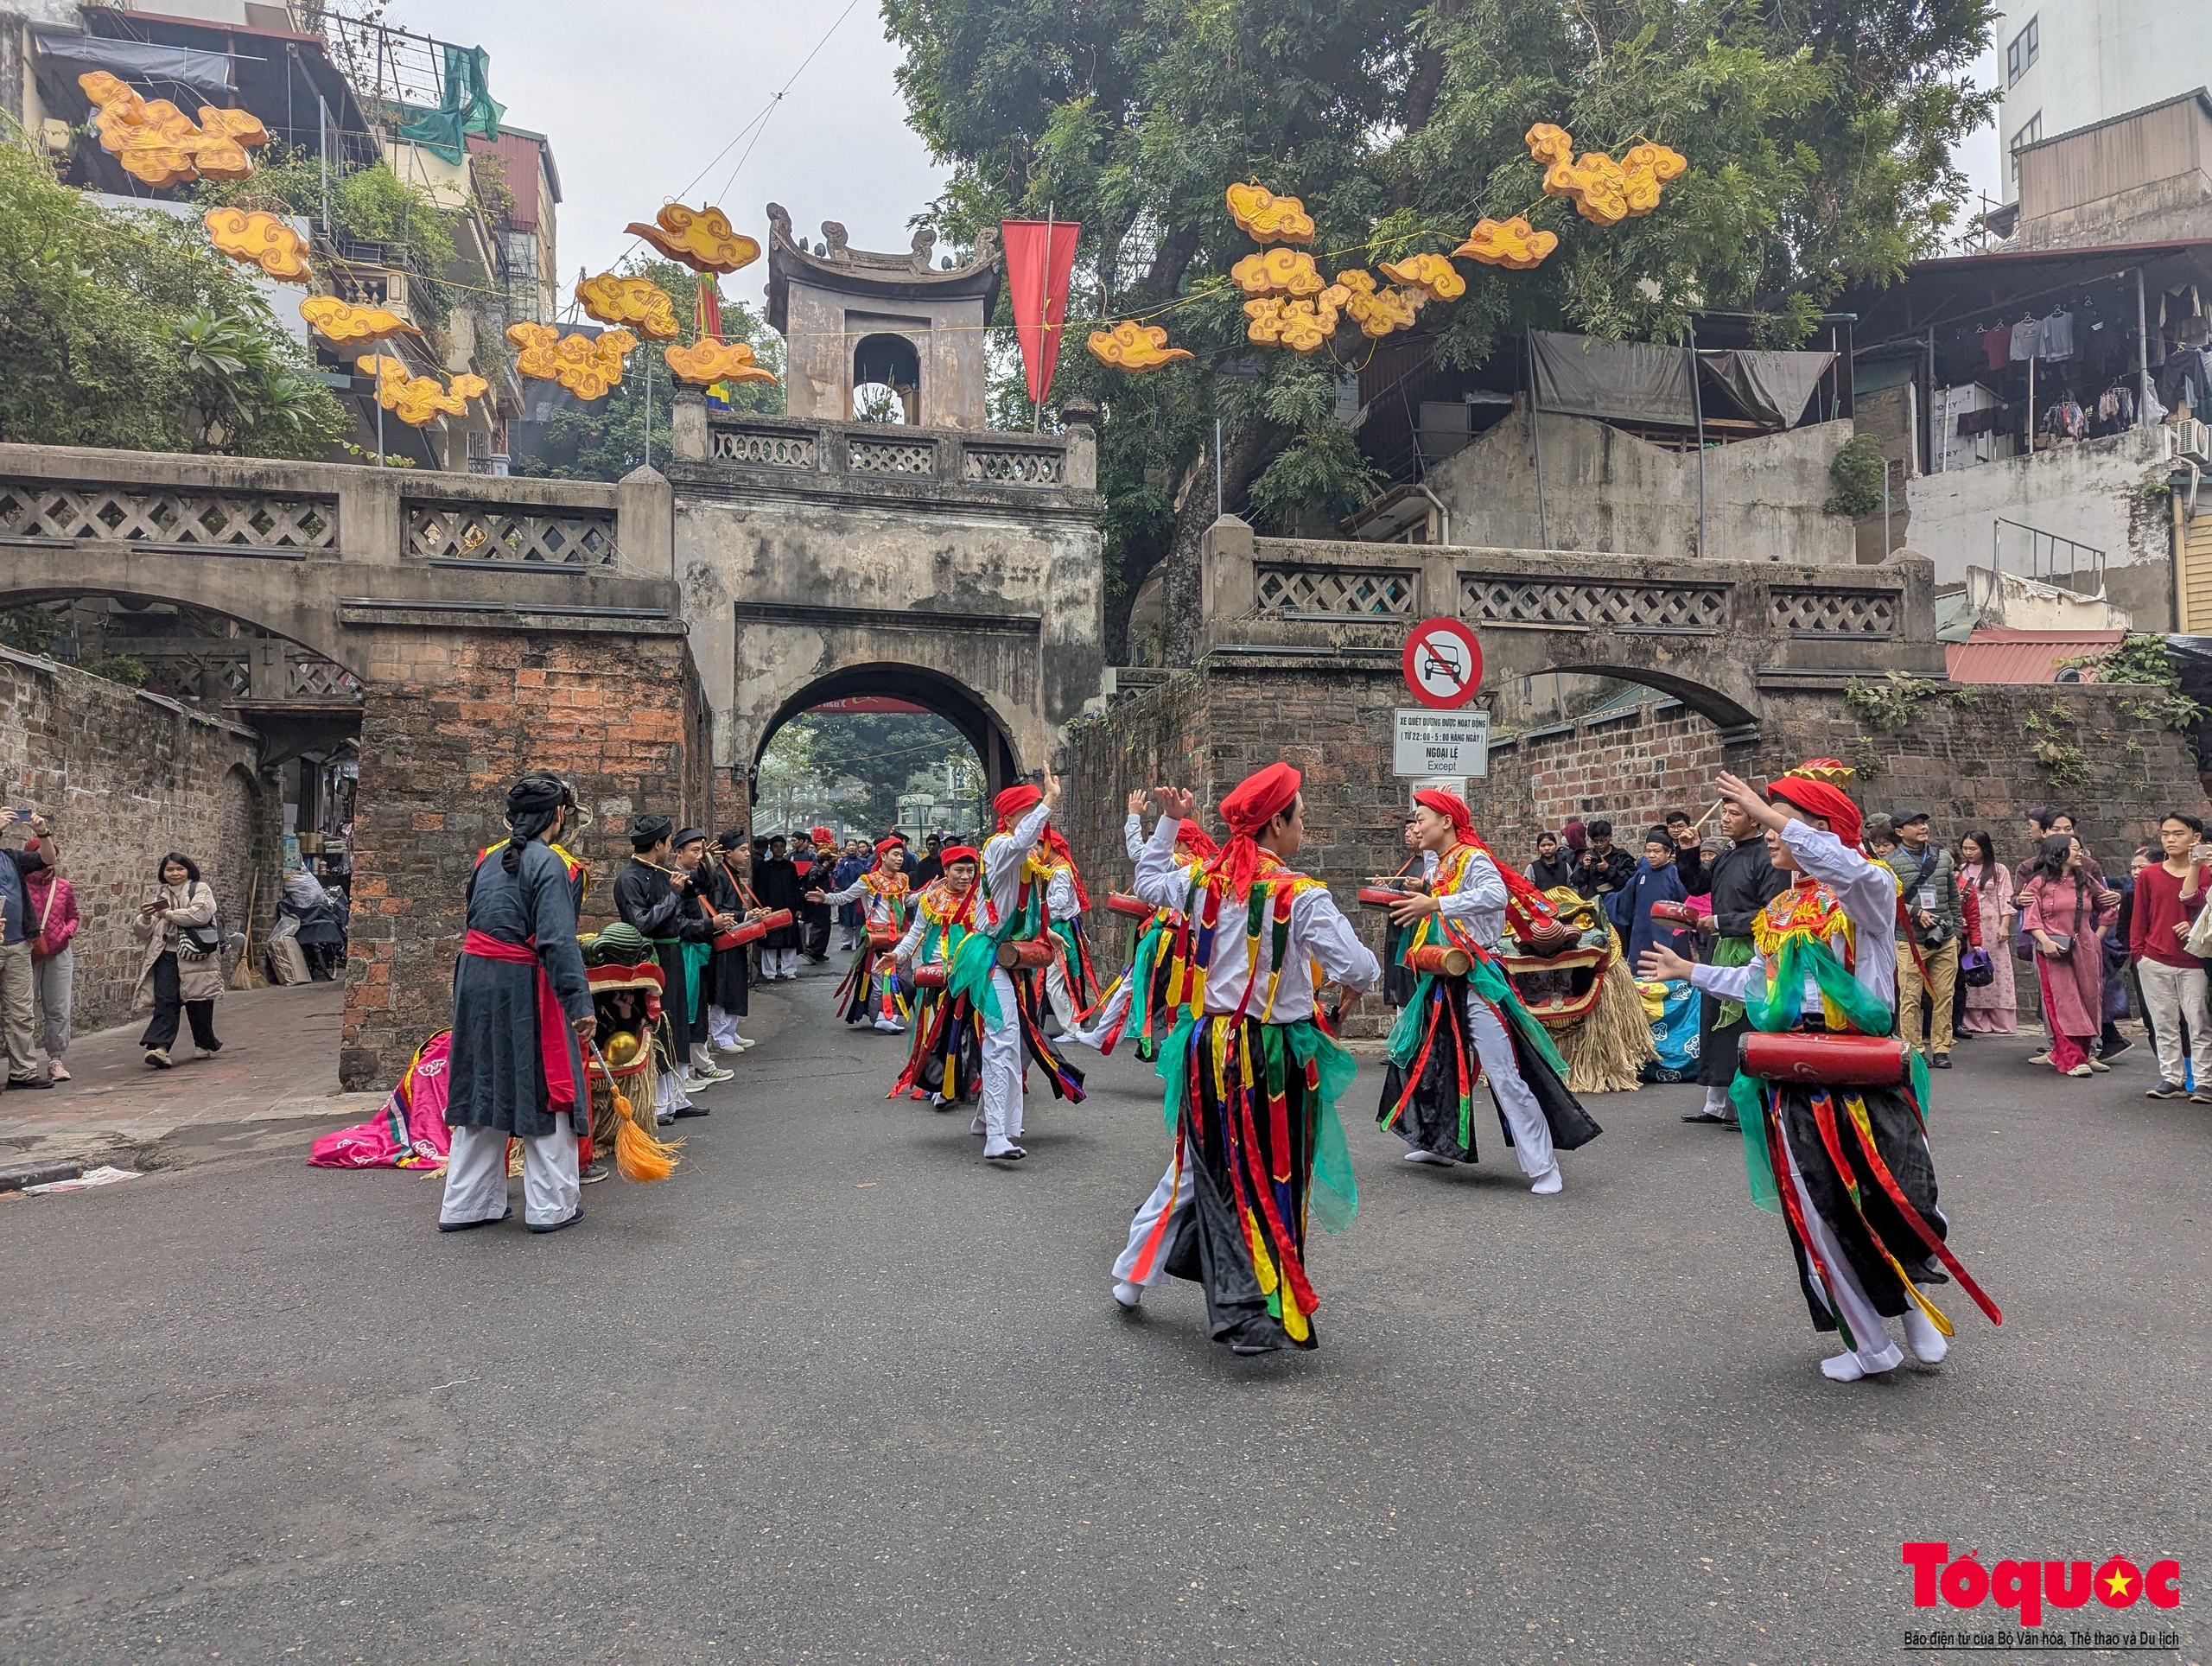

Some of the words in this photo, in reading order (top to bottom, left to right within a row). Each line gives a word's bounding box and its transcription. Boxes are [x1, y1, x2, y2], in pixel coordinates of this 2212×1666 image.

[1400, 716, 1407, 726] XE
[1408, 715, 1422, 726] QUÉT
[1422, 715, 1441, 727] ĐƯỜNG
[1442, 717, 1456, 728] ĐƯỢC
[1457, 719, 1471, 729] HOẠT
[1471, 719, 1486, 730] ĐỘNG
[1450, 731, 1465, 742] HÀNG
[1426, 747, 1448, 760] NGOẠI
[1450, 746, 1459, 760] LỆ
[1427, 760, 1457, 773] Except
